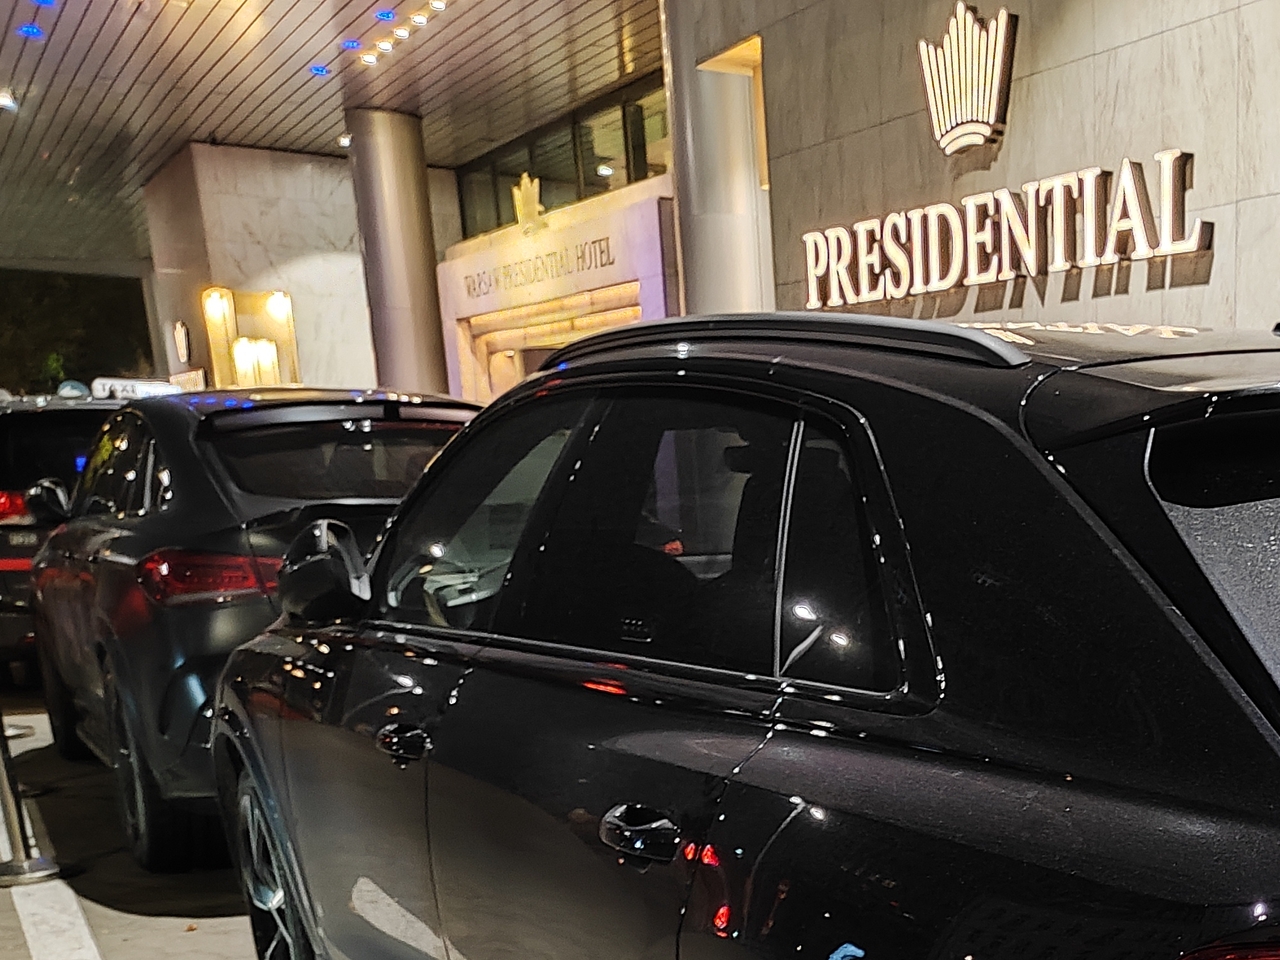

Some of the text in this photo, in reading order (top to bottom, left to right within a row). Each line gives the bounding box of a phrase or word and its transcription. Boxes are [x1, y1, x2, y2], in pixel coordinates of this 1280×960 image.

[802, 148, 1202, 310] PRESIDENTIAL
[575, 236, 616, 273] HOTEL
[101, 382, 137, 395] TAXI
